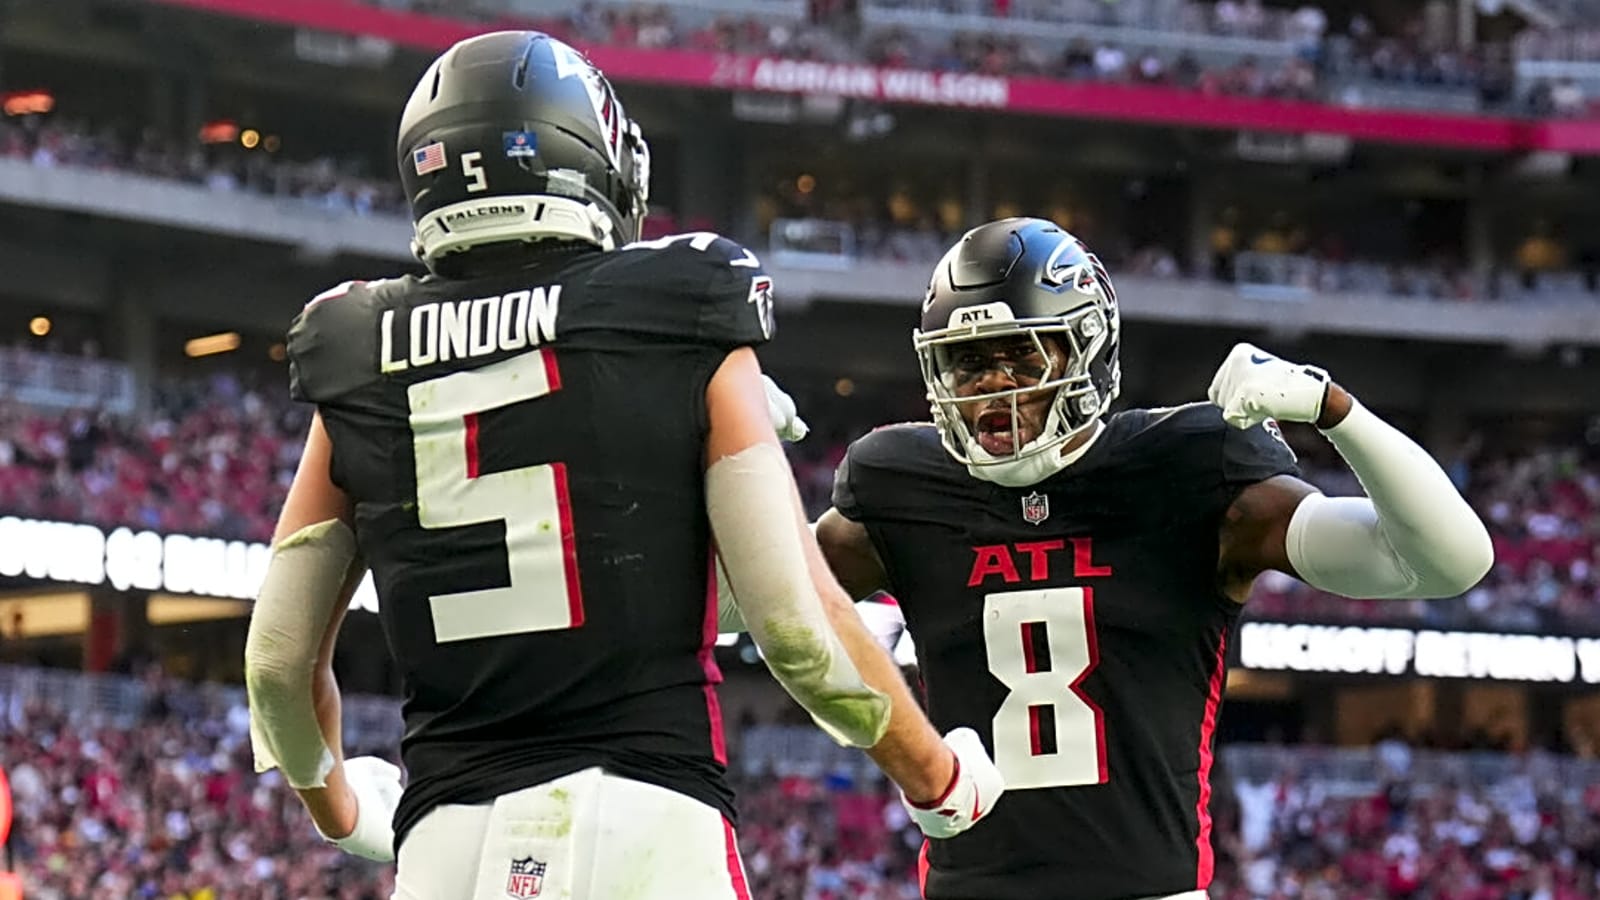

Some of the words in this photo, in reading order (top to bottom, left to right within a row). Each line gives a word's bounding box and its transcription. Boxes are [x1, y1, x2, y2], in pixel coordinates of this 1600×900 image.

[753, 58, 877, 96] ADRIAN
[879, 68, 1008, 107] WILSON
[461, 151, 488, 192] 5
[446, 205, 526, 222] FALCONS
[380, 284, 562, 374] LONDON
[960, 309, 993, 323] ATL
[407, 348, 585, 644] 5
[1026, 505, 1048, 519] NFL
[967, 537, 1113, 587] ATL
[983, 586, 1110, 790] 8
[509, 874, 538, 897] NFL
